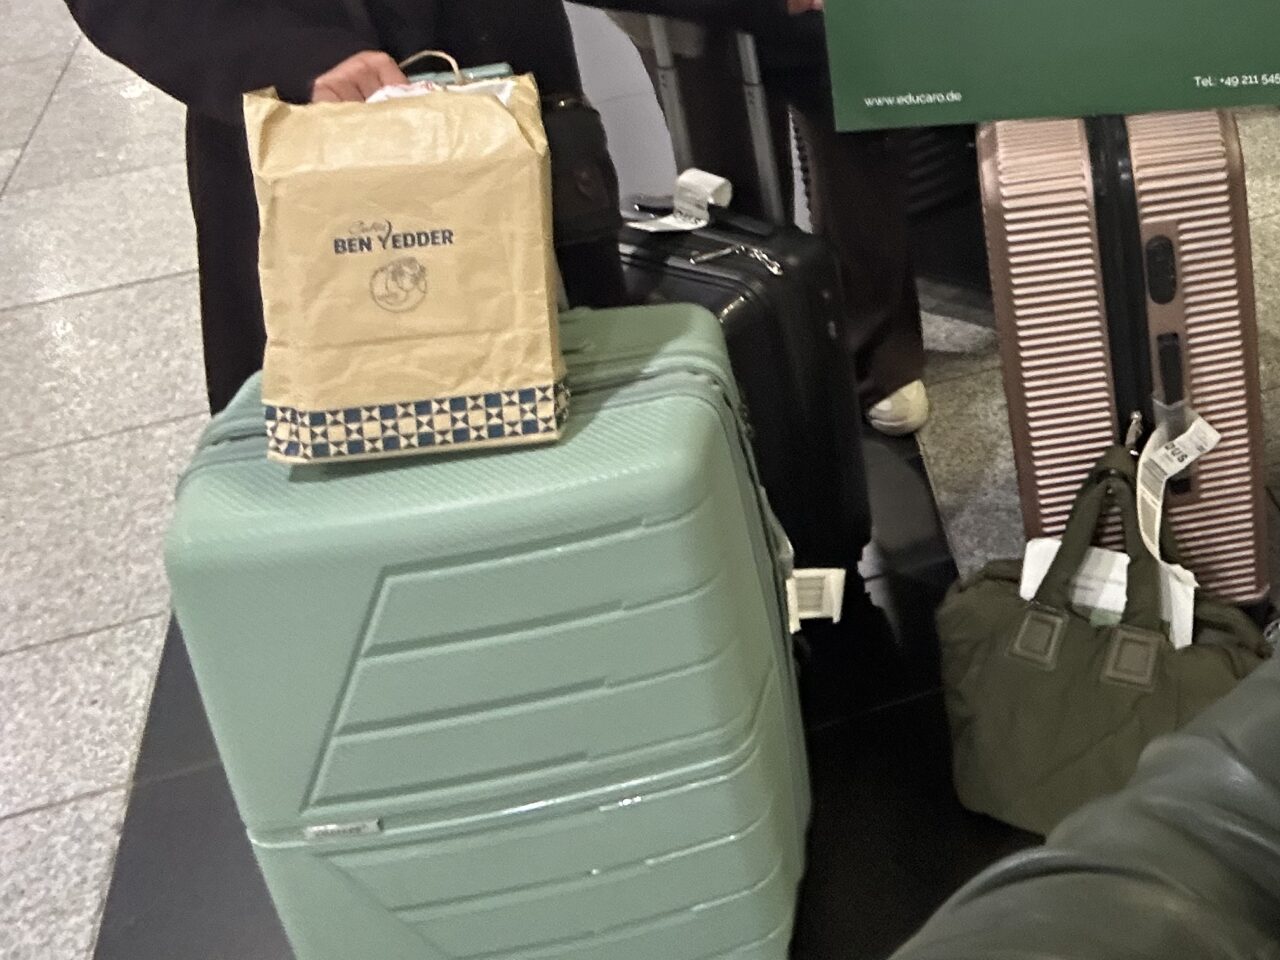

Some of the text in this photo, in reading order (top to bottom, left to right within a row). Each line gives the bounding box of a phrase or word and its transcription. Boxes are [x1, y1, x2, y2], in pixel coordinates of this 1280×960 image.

[1241, 74, 1259, 86] 211
[863, 90, 963, 108] www.educaro.de
[333, 236, 373, 254] BEN
[377, 219, 454, 250] YEDDER
